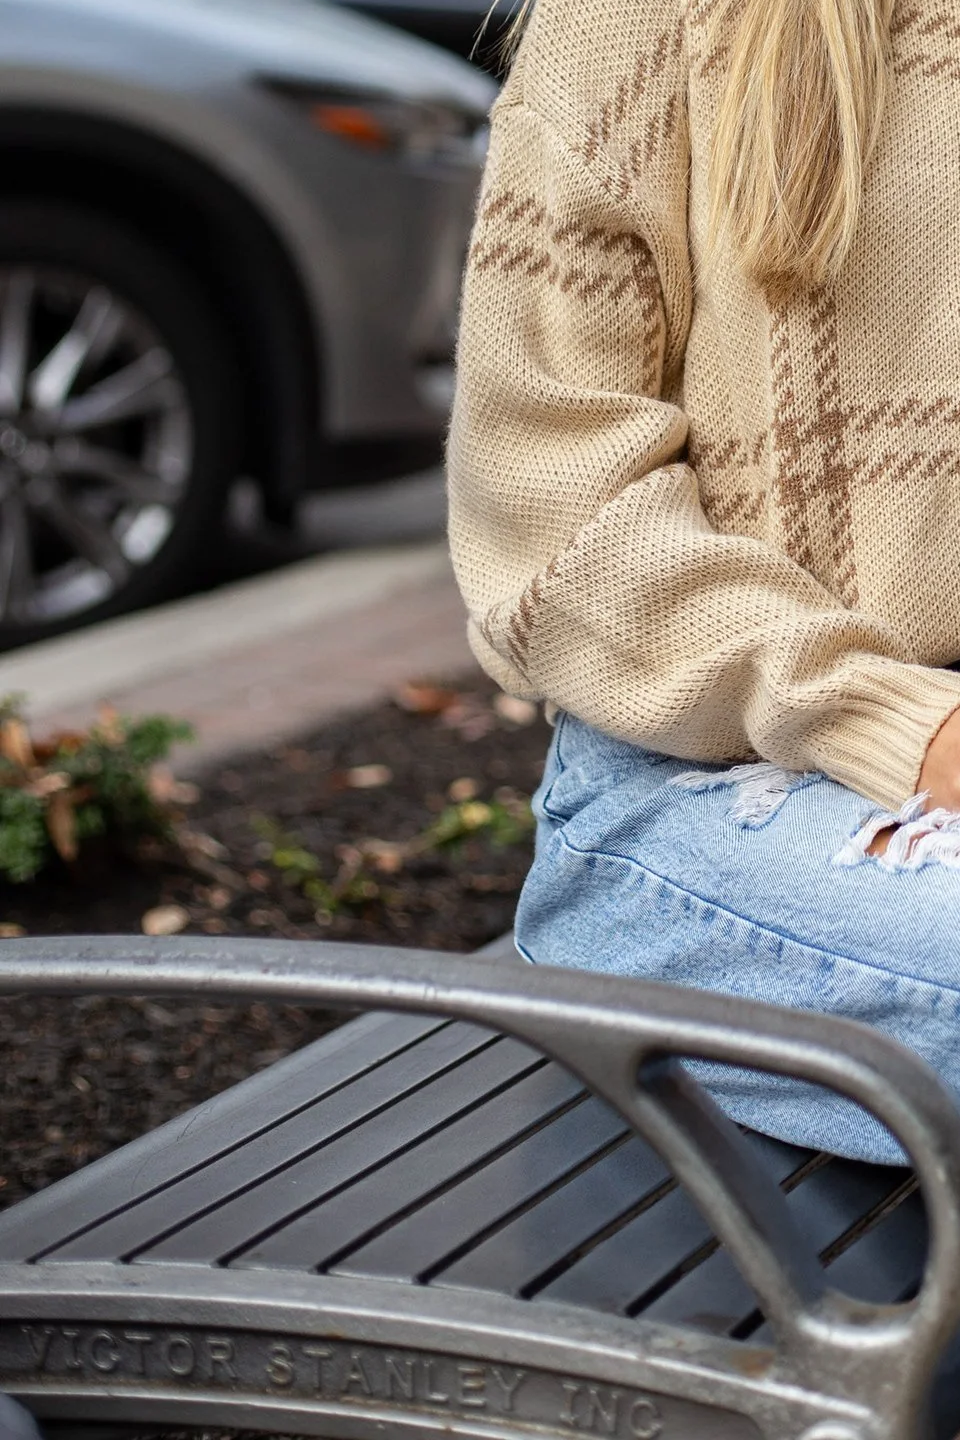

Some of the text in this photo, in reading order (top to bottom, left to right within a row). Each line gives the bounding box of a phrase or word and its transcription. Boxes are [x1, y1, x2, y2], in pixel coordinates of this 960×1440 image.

[20, 1324, 663, 1436] VICTOR STANLEY INC
